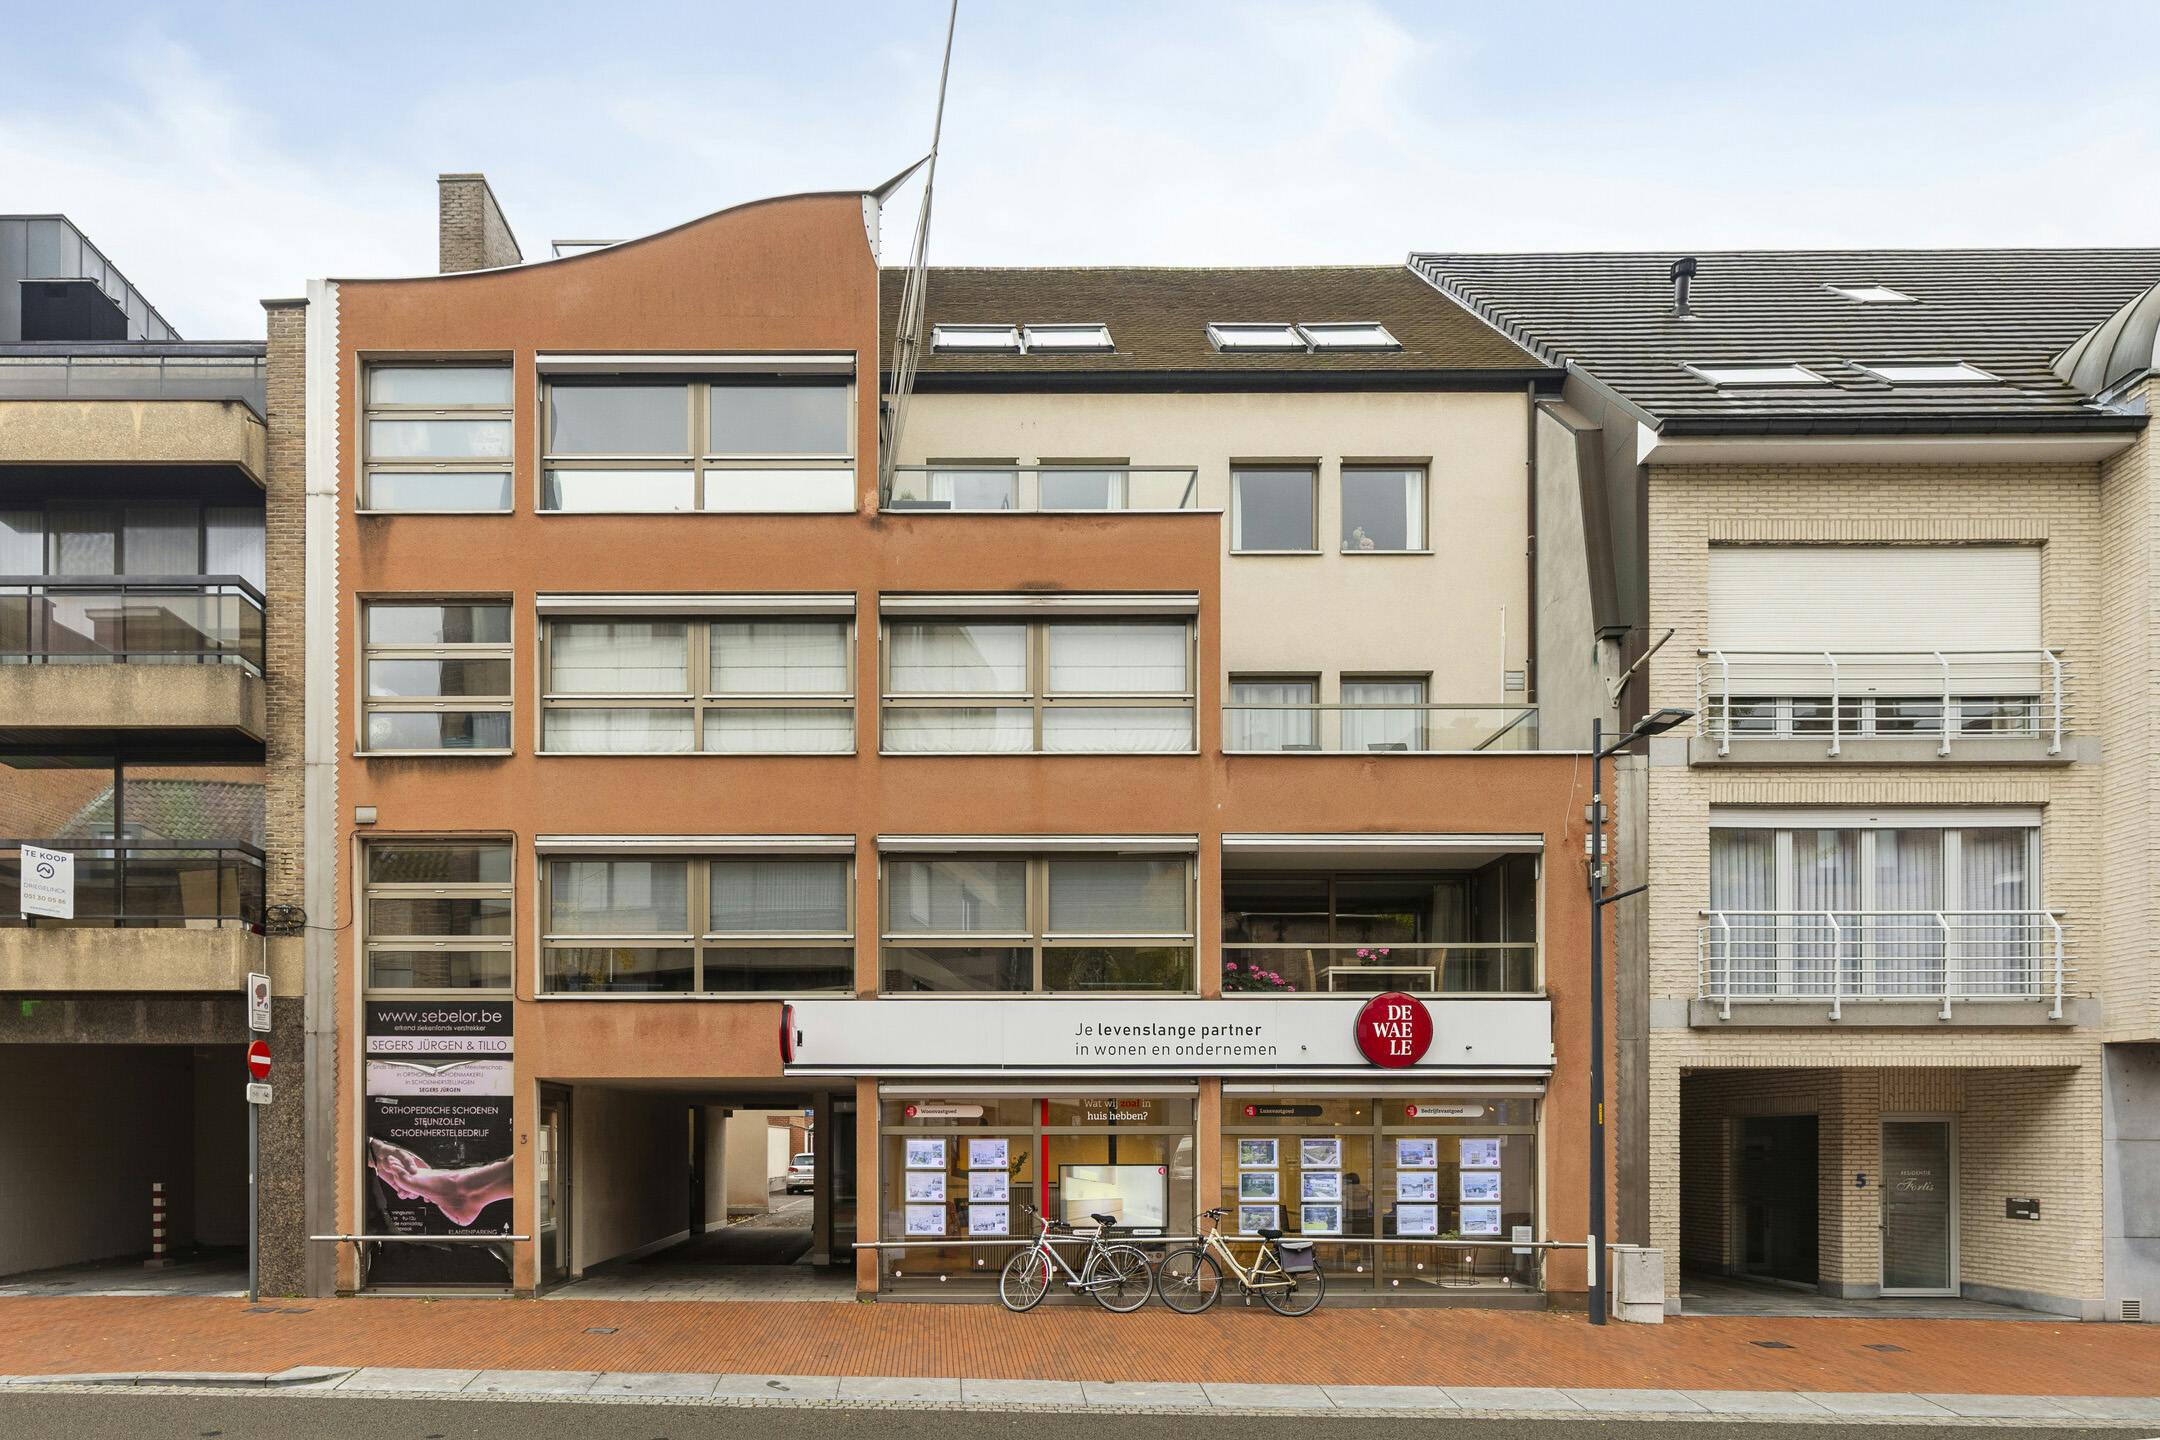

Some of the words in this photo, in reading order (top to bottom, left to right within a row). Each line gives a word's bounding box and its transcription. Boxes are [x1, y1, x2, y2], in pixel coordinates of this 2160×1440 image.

[24, 849, 37, 858] TE
[40, 852, 67, 863] KOOP
[377, 1009, 502, 1024] www.sebelor.be
[1387, 1004, 1413, 1021] DE
[1075, 1022, 1093, 1037] Je
[1098, 1022, 1197, 1040] levenslange
[1201, 1023, 1263, 1040] partner
[1372, 1022, 1413, 1038] WAE
[372, 1040, 414, 1051] SEGERS
[417, 1038, 463, 1051] JÜRGEN
[466, 1040, 475, 1051] &
[478, 1040, 507, 1051] TILLO
[1075, 1042, 1089, 1056] in
[1094, 1044, 1147, 1056] wonen
[1152, 1044, 1171, 1056] en
[1175, 1042, 1278, 1056] ondernemen
[1389, 1039, 1413, 1056] LE
[381, 1106, 451, 1116] ORTHOPEDISCHE
[452, 1106, 499, 1115] SCHOENEN
[920, 1107, 958, 1115] Woonvastgoed
[1083, 1099, 1103, 1108] Wat
[1104, 1099, 1119, 1110] wij
[1141, 1099, 1152, 1108] in
[414, 1117, 466, 1126] STEUNZOLEN
[1087, 1111, 1108, 1121] huis
[1109, 1111, 1149, 1121] hebben?
[390, 1128, 490, 1138] SCHOENHERSTELBEDRIJF
[519, 1134, 529, 1145] 3
[1855, 1173, 1867, 1189] 5
[1896, 1177, 1935, 1192] Fortis
